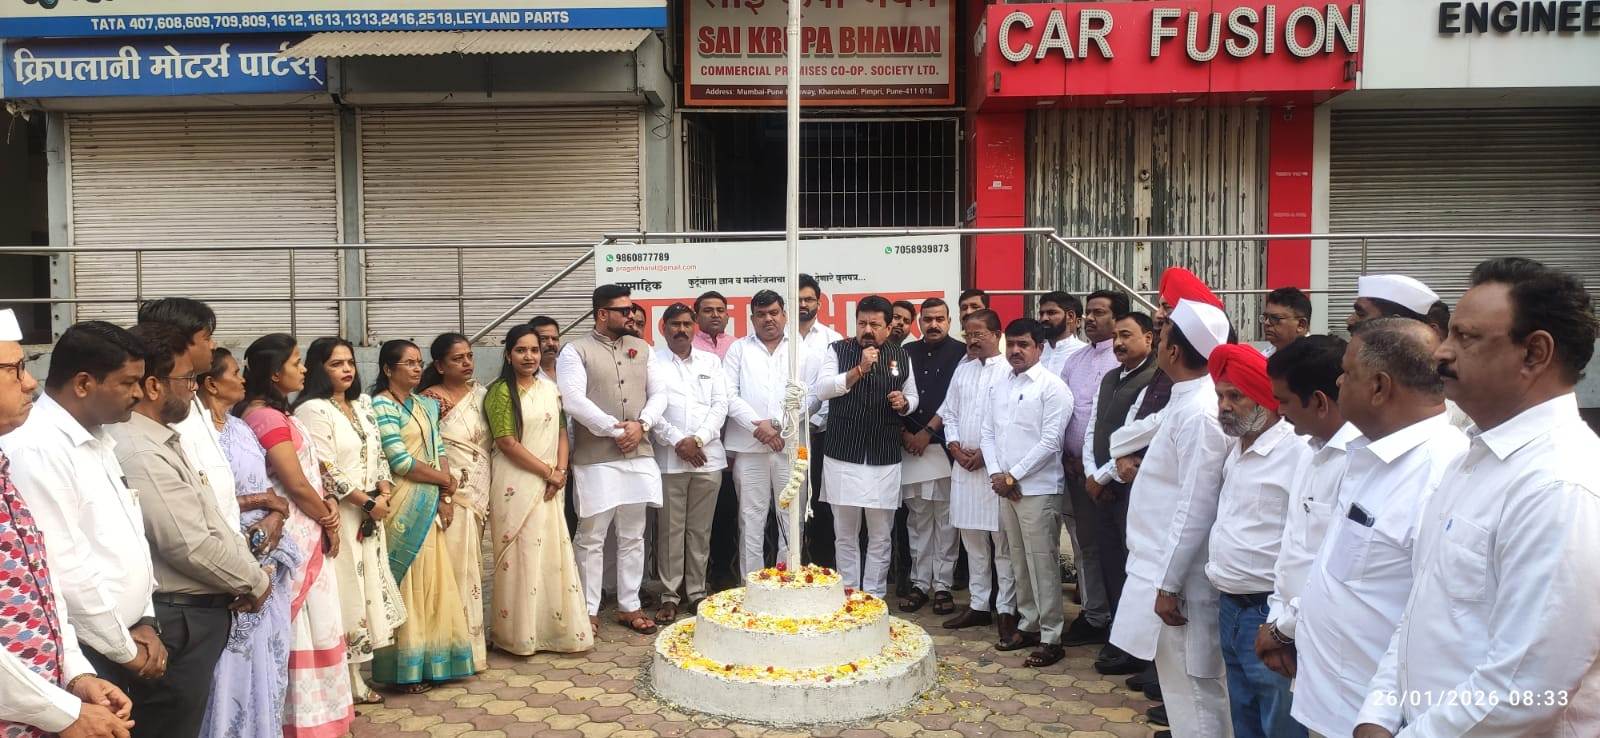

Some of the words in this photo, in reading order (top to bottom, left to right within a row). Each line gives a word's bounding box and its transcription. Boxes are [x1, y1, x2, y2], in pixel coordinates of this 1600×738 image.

[91, 18, 126, 30] TATA
[524, 11, 569, 24] PARTS
[698, 26, 741, 56] SAI
[839, 25, 941, 56] BHAVAN
[999, 9, 1114, 62] CAR
[1151, 4, 1360, 61] FUSION
[14, 45, 141, 85] क्रिपलानी
[149, 43, 231, 79] मोटर्स
[701, 65, 771, 76] COMMERCIAL
[775, 65, 827, 76] PRMISES
[831, 65, 867, 76] CO-OP.
[871, 65, 914, 76] SOCIETY
[917, 65, 939, 76] LTD.
[705, 88, 734, 96] Address:
[737, 88, 783, 96] Mumbai-Pune
[786, 89, 816, 98] way,
[895, 244, 949, 254] 7058939873
[616, 252, 669, 262] 9860877789
